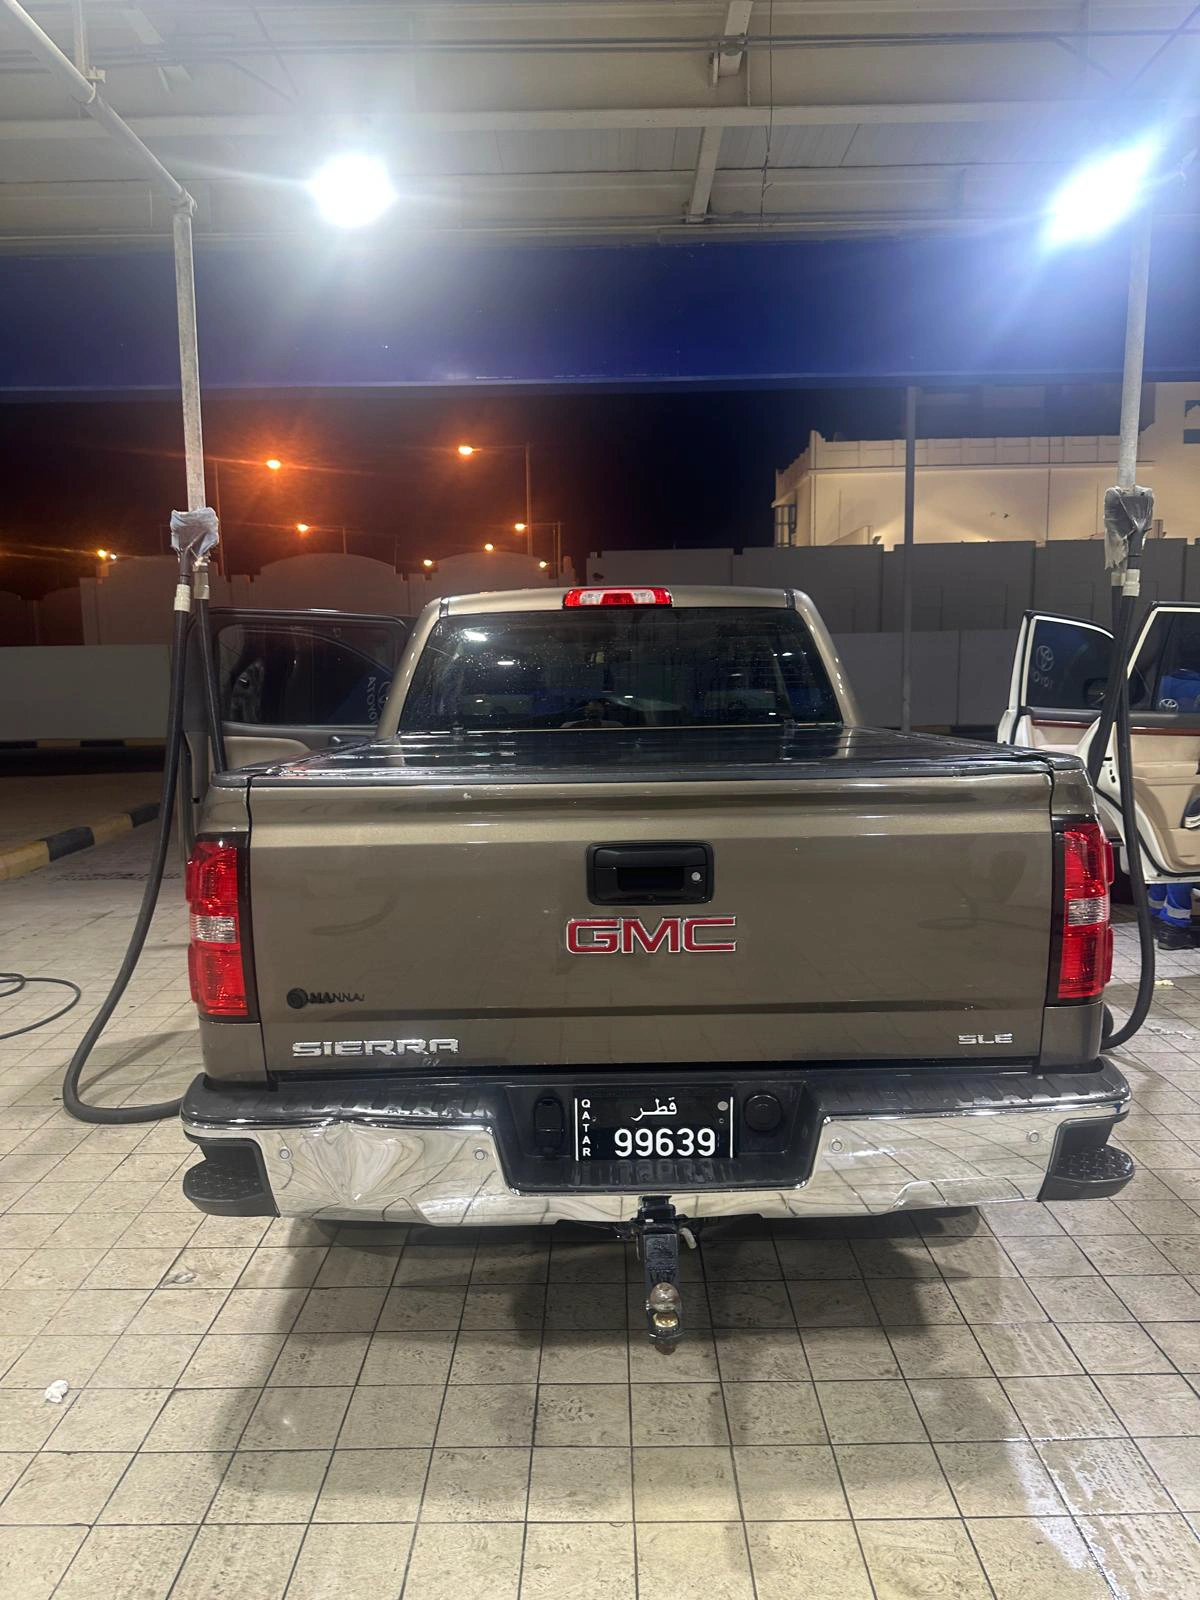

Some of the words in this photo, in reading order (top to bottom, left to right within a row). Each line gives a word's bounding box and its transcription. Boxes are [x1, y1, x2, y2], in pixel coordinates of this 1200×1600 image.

[566, 917, 737, 953] GMC
[292, 1038, 459, 1057] SIERRA
[958, 1033, 1012, 1044] SLE
[630, 1097, 678, 1121] قطر
[581, 1099, 592, 1157] QATAR
[614, 1127, 716, 1157] 99639
